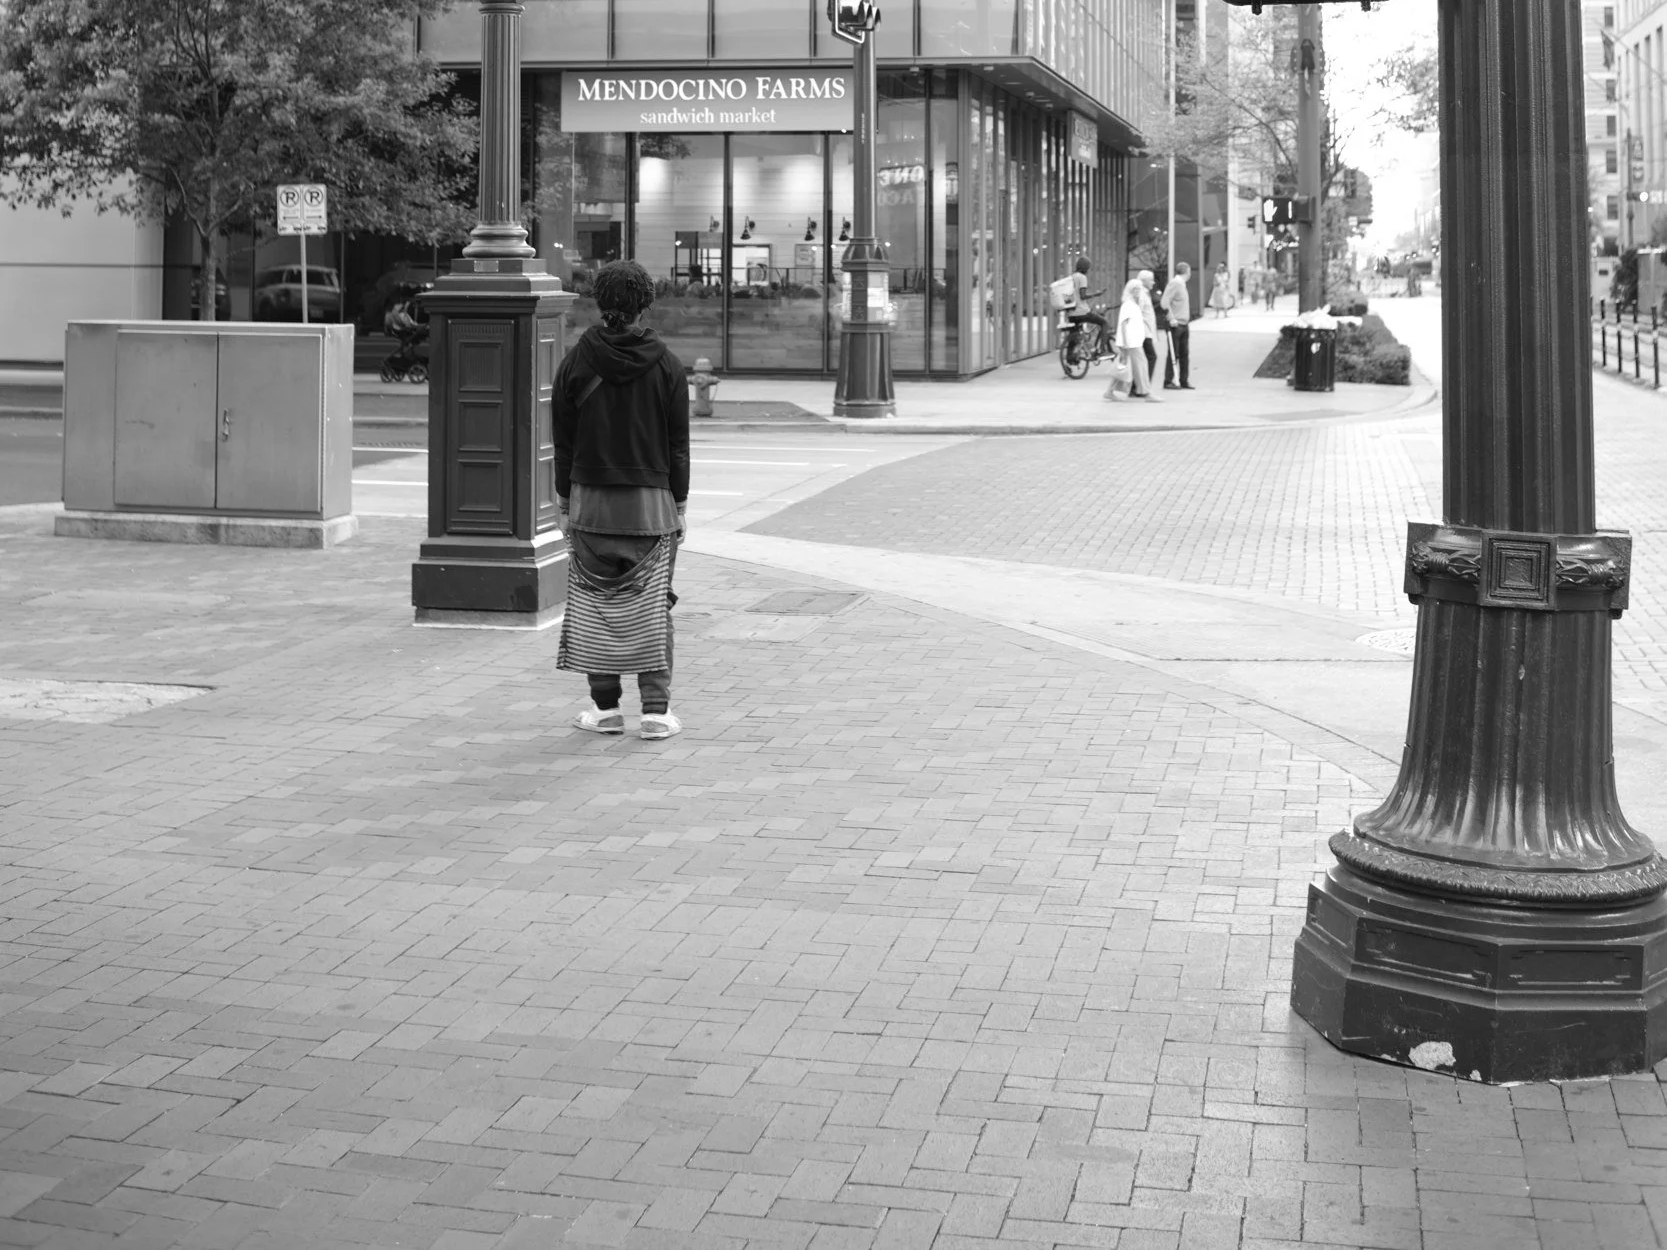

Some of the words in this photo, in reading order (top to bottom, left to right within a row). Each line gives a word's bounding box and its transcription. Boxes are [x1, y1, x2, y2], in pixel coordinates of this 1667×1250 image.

[578, 78, 747, 101] MENDOCINO
[755, 76, 846, 100] FARMS
[640, 107, 715, 125] sandwich
[720, 106, 777, 124] market
